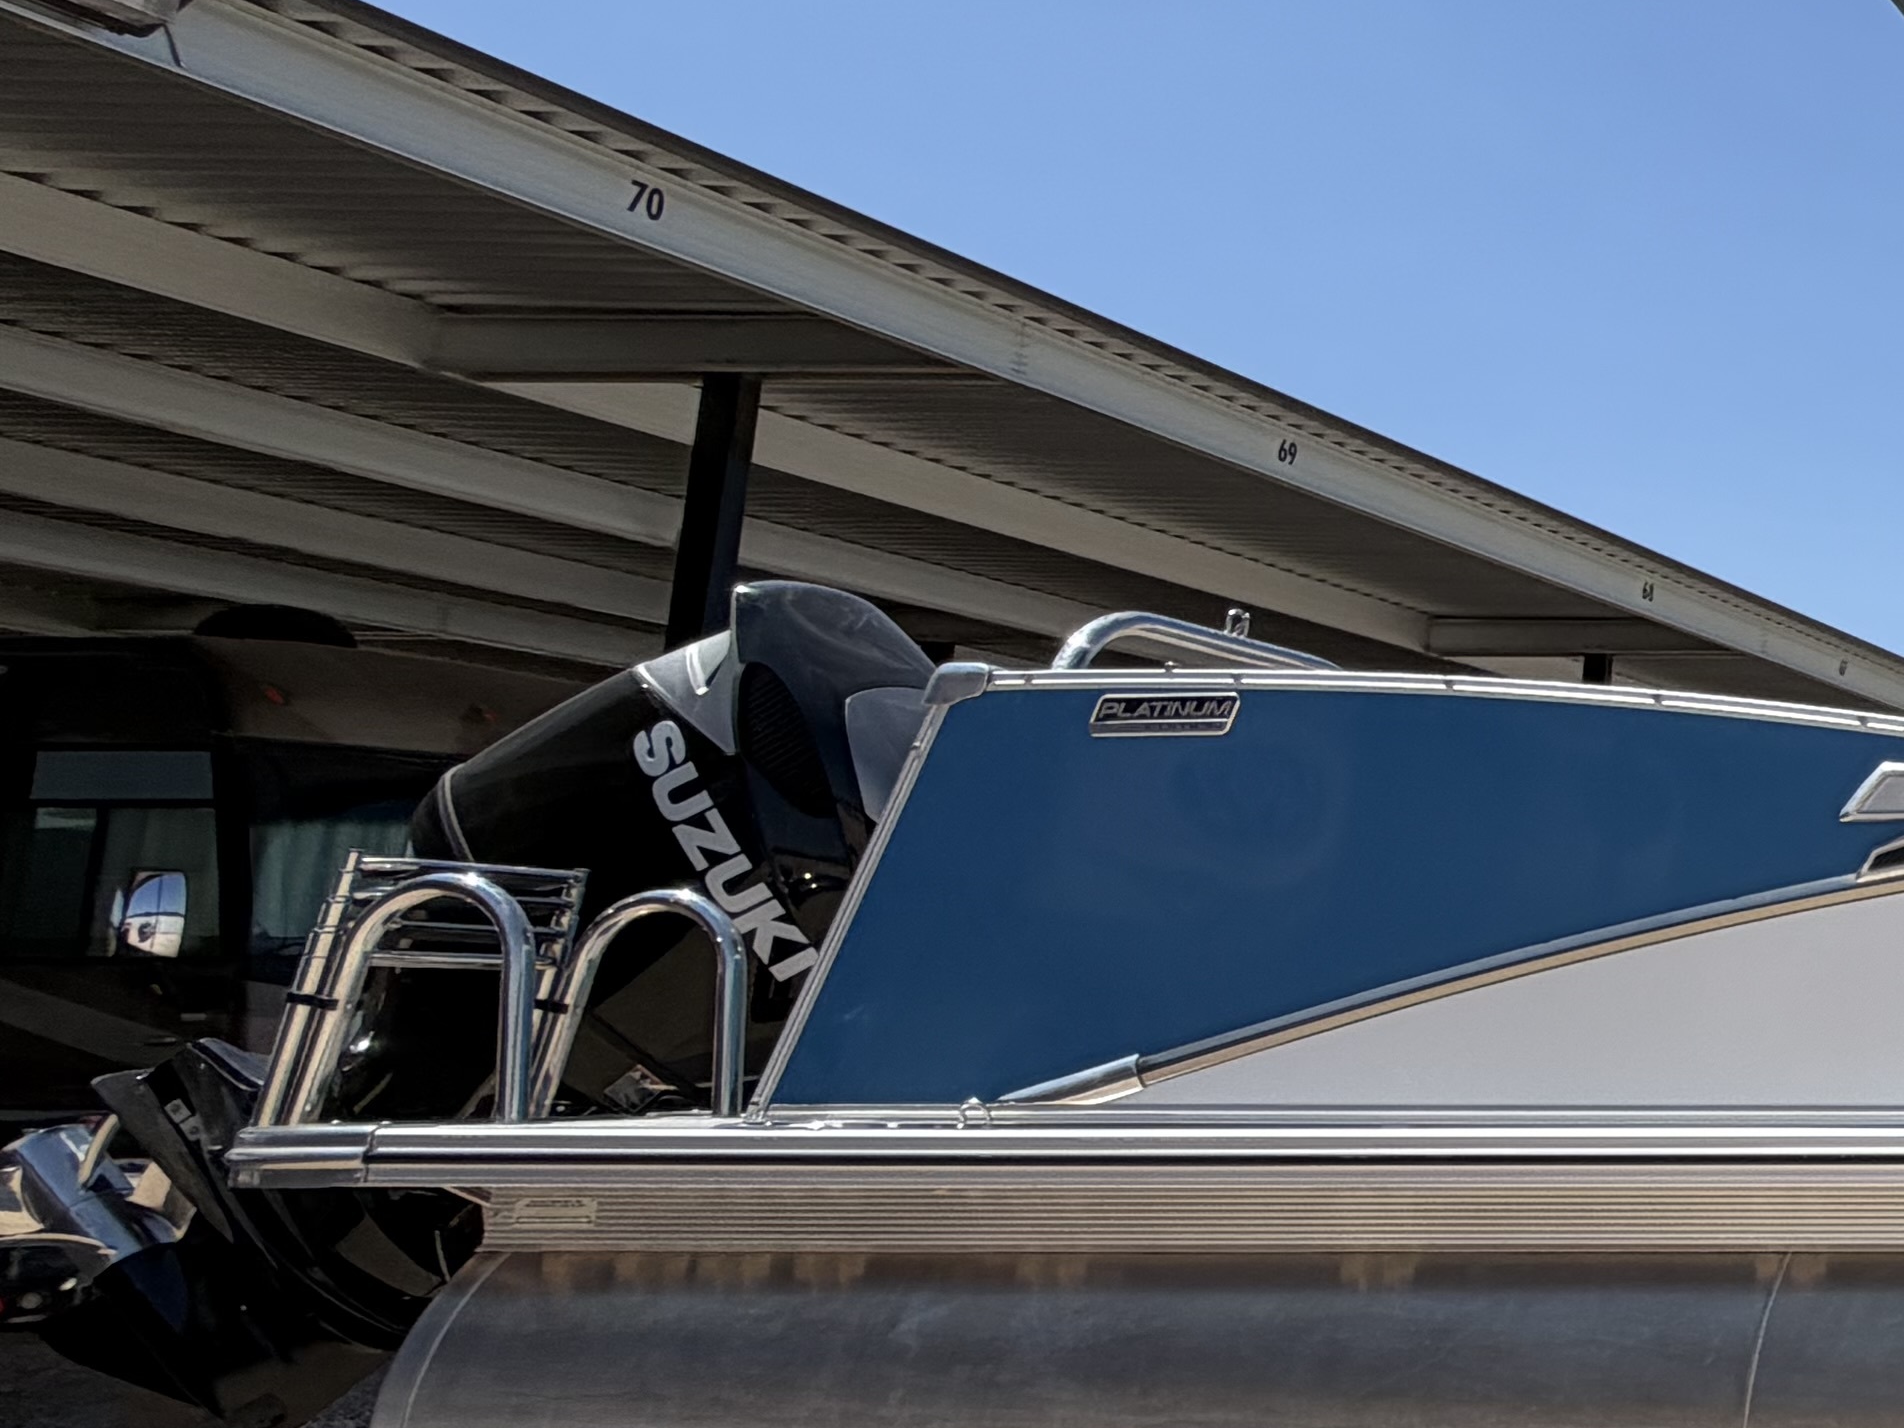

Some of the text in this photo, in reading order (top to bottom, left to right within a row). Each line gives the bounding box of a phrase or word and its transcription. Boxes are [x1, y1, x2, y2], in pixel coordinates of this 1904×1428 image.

[627, 179, 665, 221] 70
[1278, 438, 1297, 465] 69
[1099, 700, 1232, 718] PLATINUM
[633, 720, 819, 982] SUZUKI
